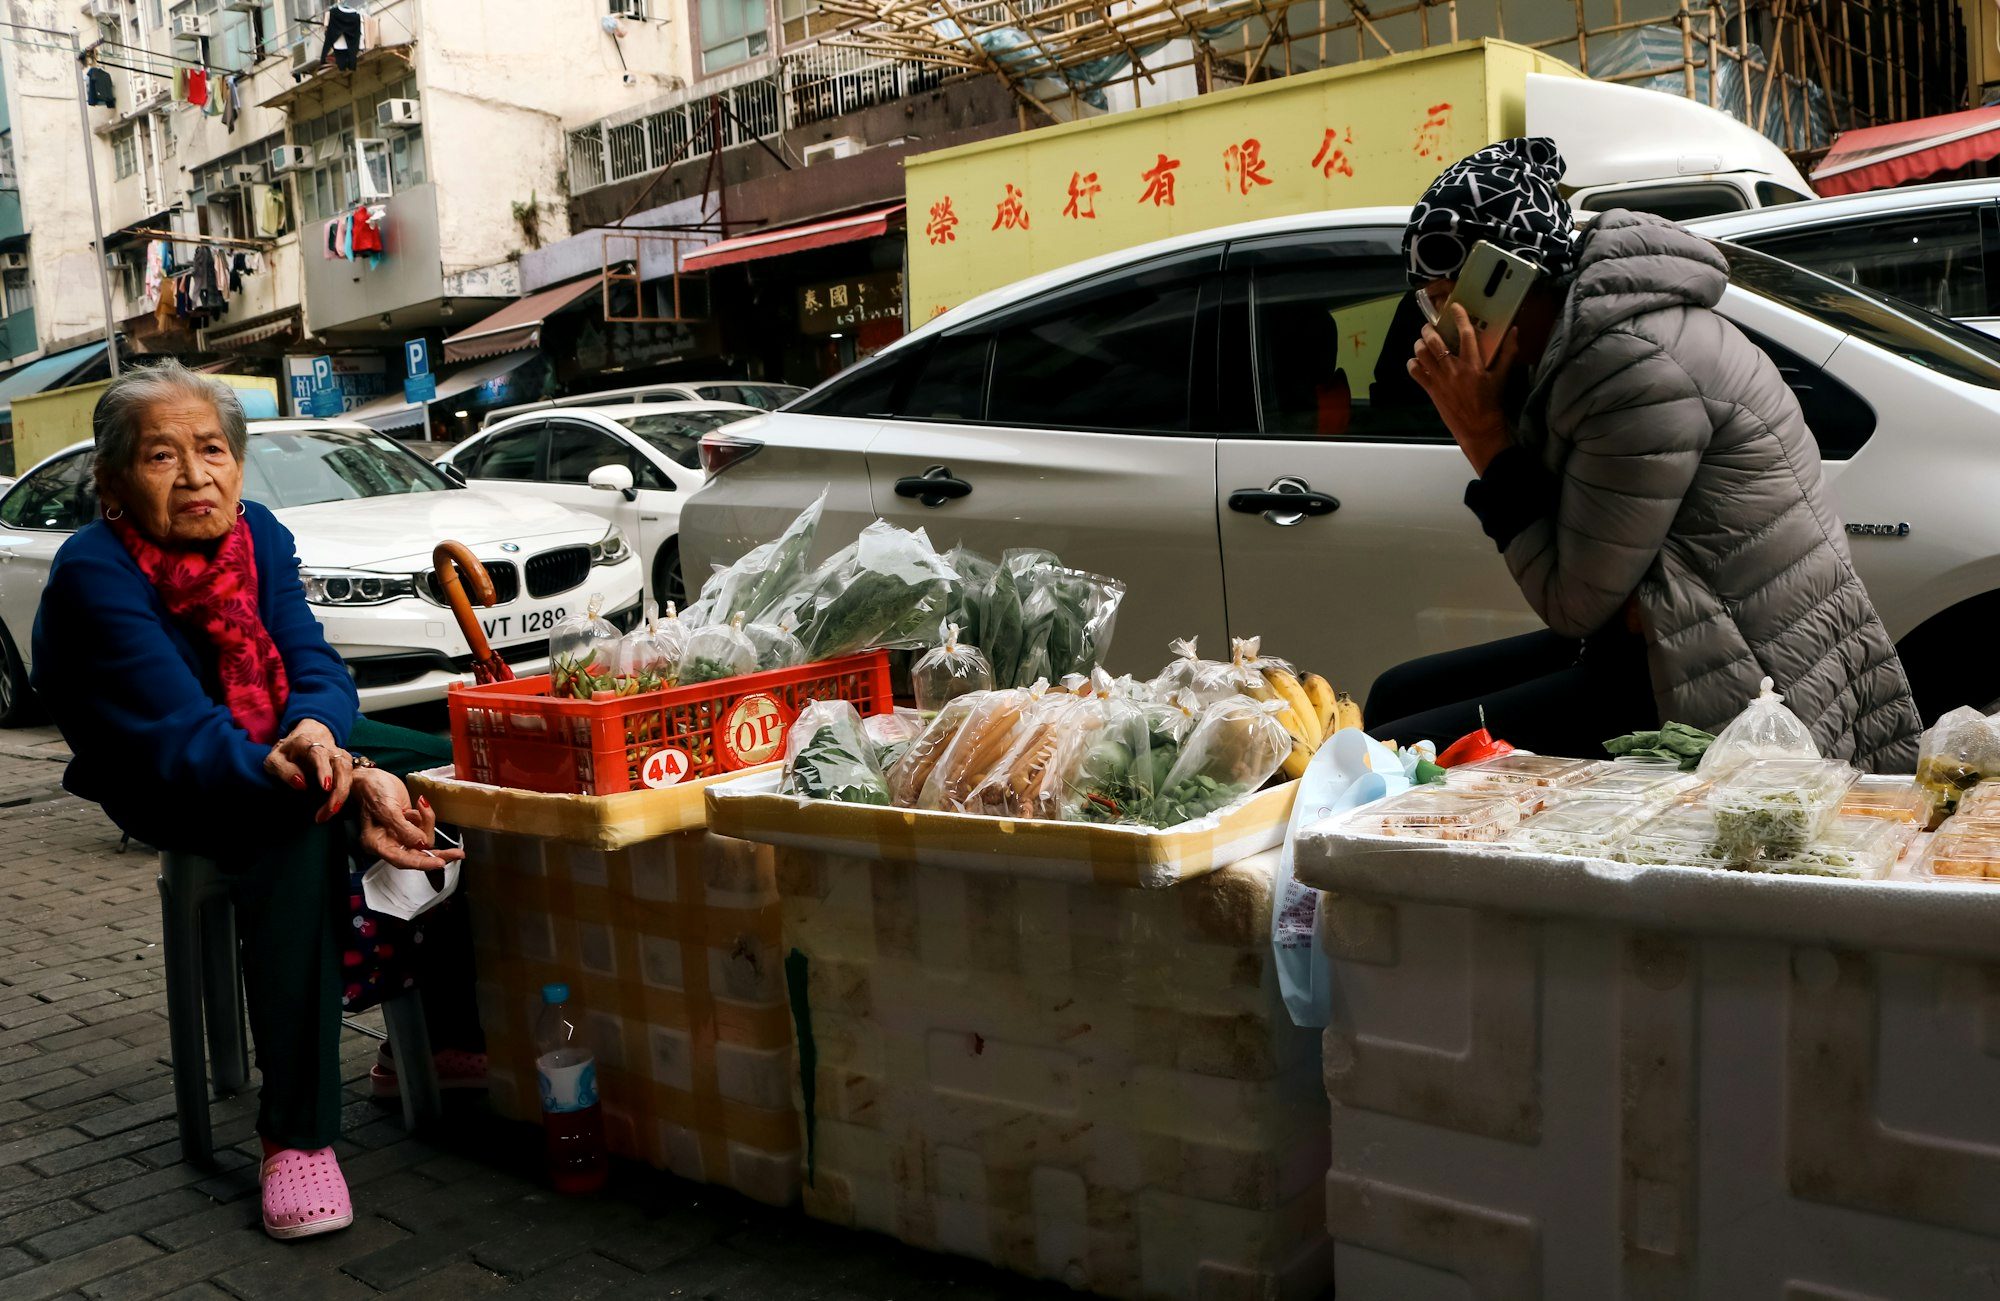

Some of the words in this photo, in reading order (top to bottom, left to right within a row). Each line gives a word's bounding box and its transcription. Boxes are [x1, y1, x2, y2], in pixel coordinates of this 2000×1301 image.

[409, 343, 423, 374] P
[315, 360, 328, 389] P
[483, 616, 511, 639] VT
[522, 607, 566, 634] 1289
[735, 713, 780, 752] OP
[648, 753, 681, 781] 4A
